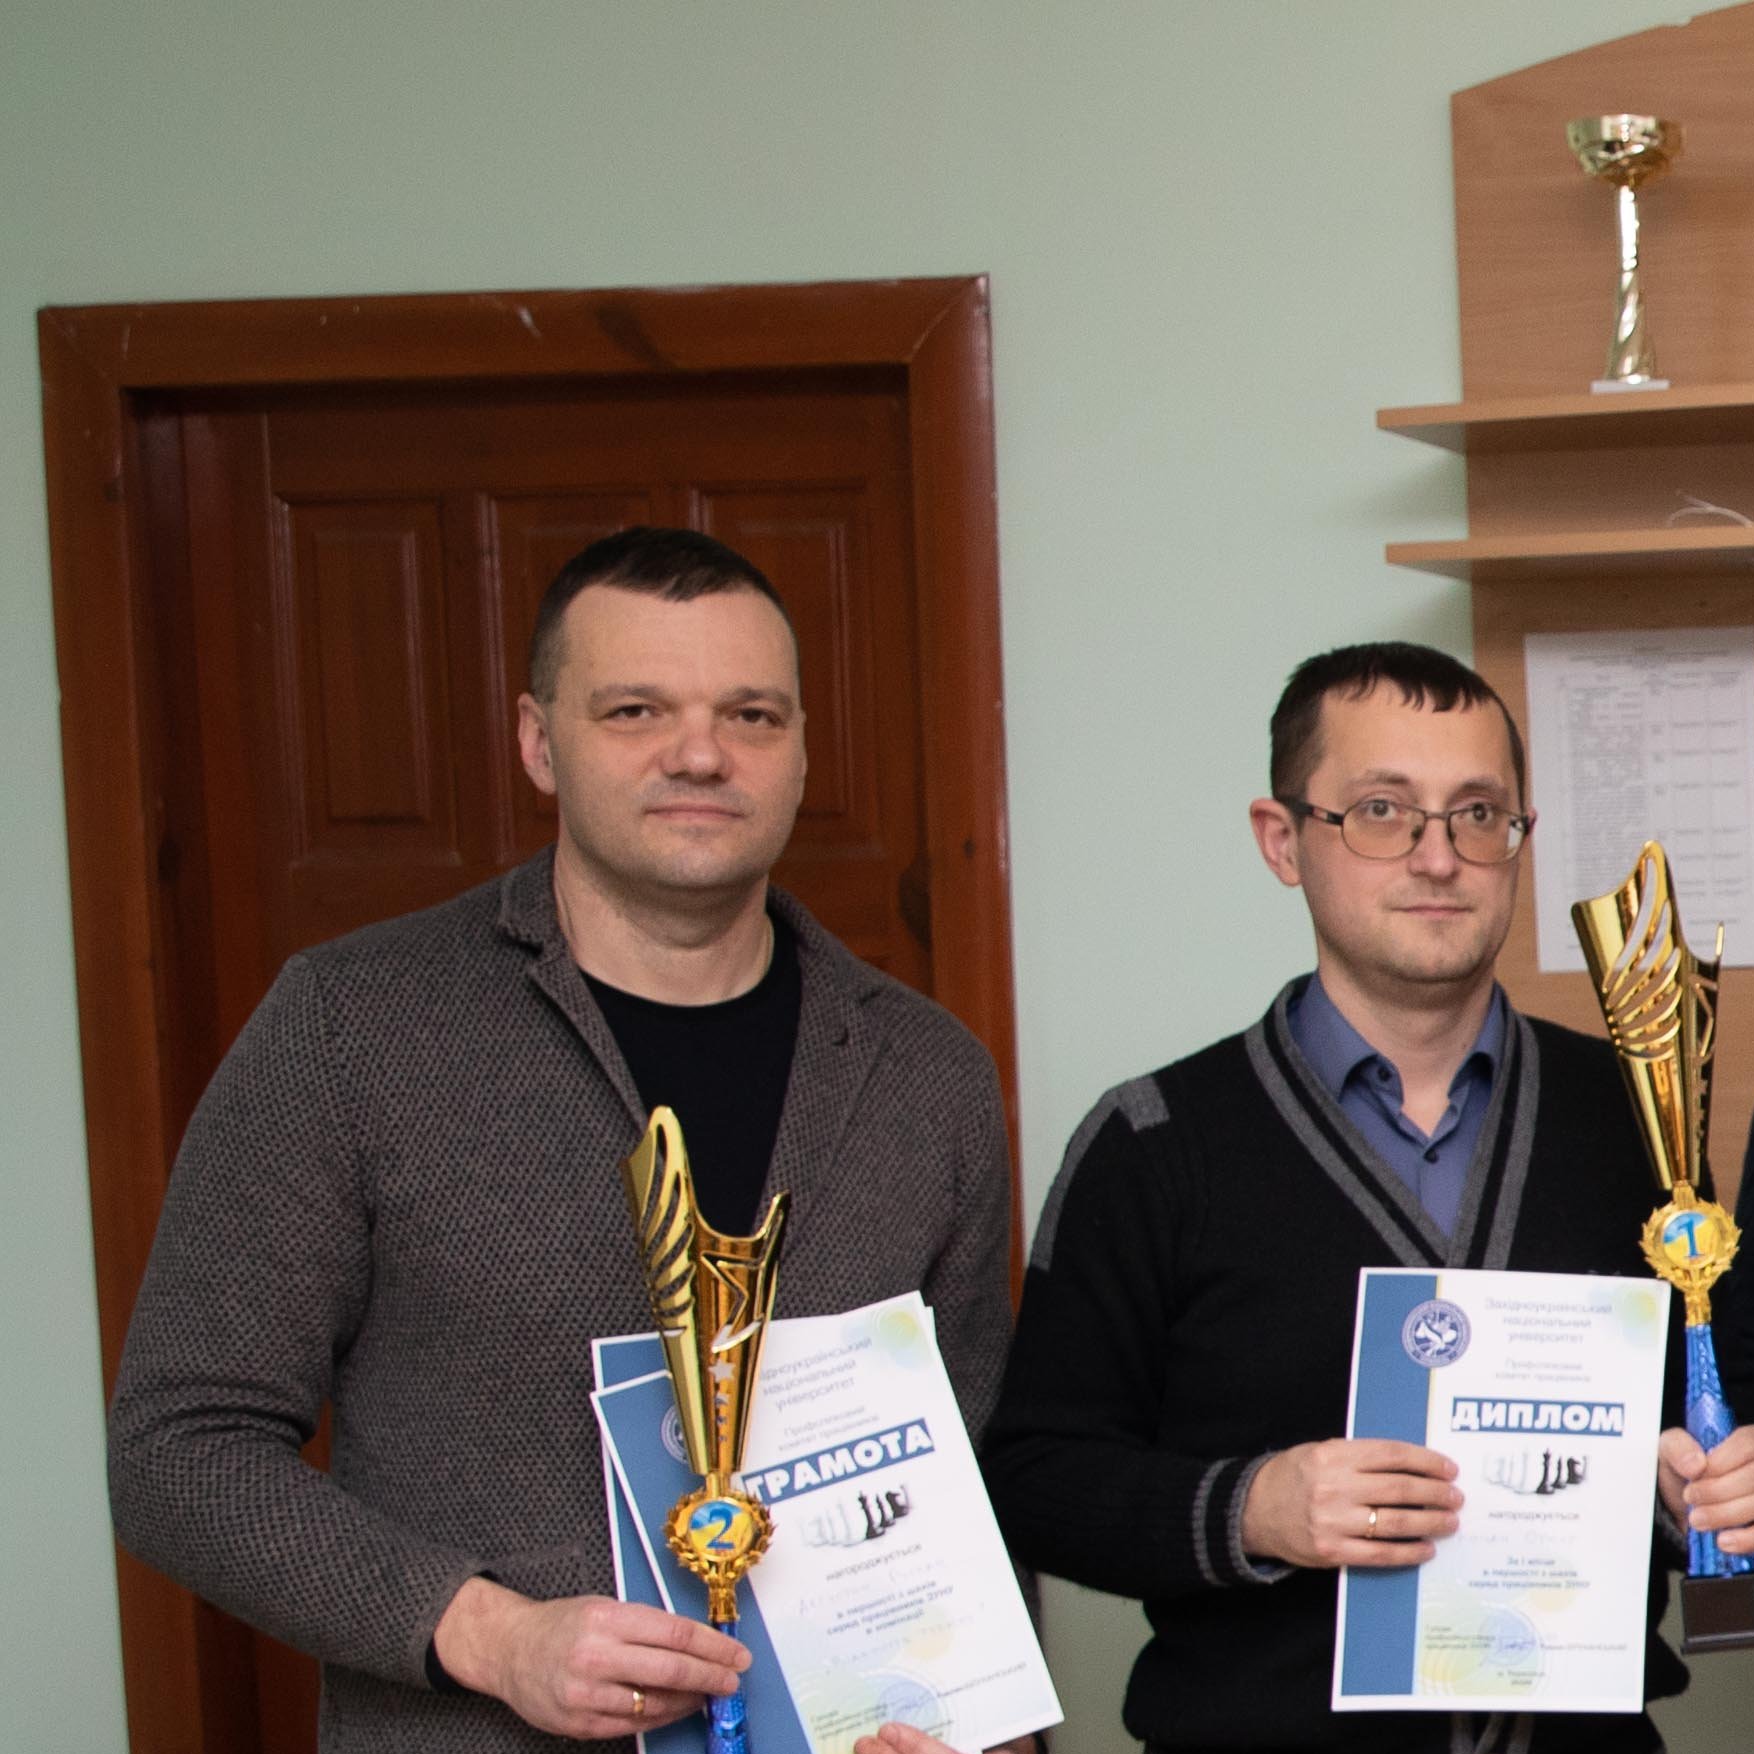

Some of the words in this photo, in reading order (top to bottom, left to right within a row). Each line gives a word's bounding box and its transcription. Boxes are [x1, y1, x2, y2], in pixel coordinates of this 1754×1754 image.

[1677, 1217, 1706, 1258] 1
[1452, 1400, 1624, 1433] ДИПЛОМ
[745, 1424, 933, 1502] ГРАМОТА
[707, 1508, 736, 1550] 2
